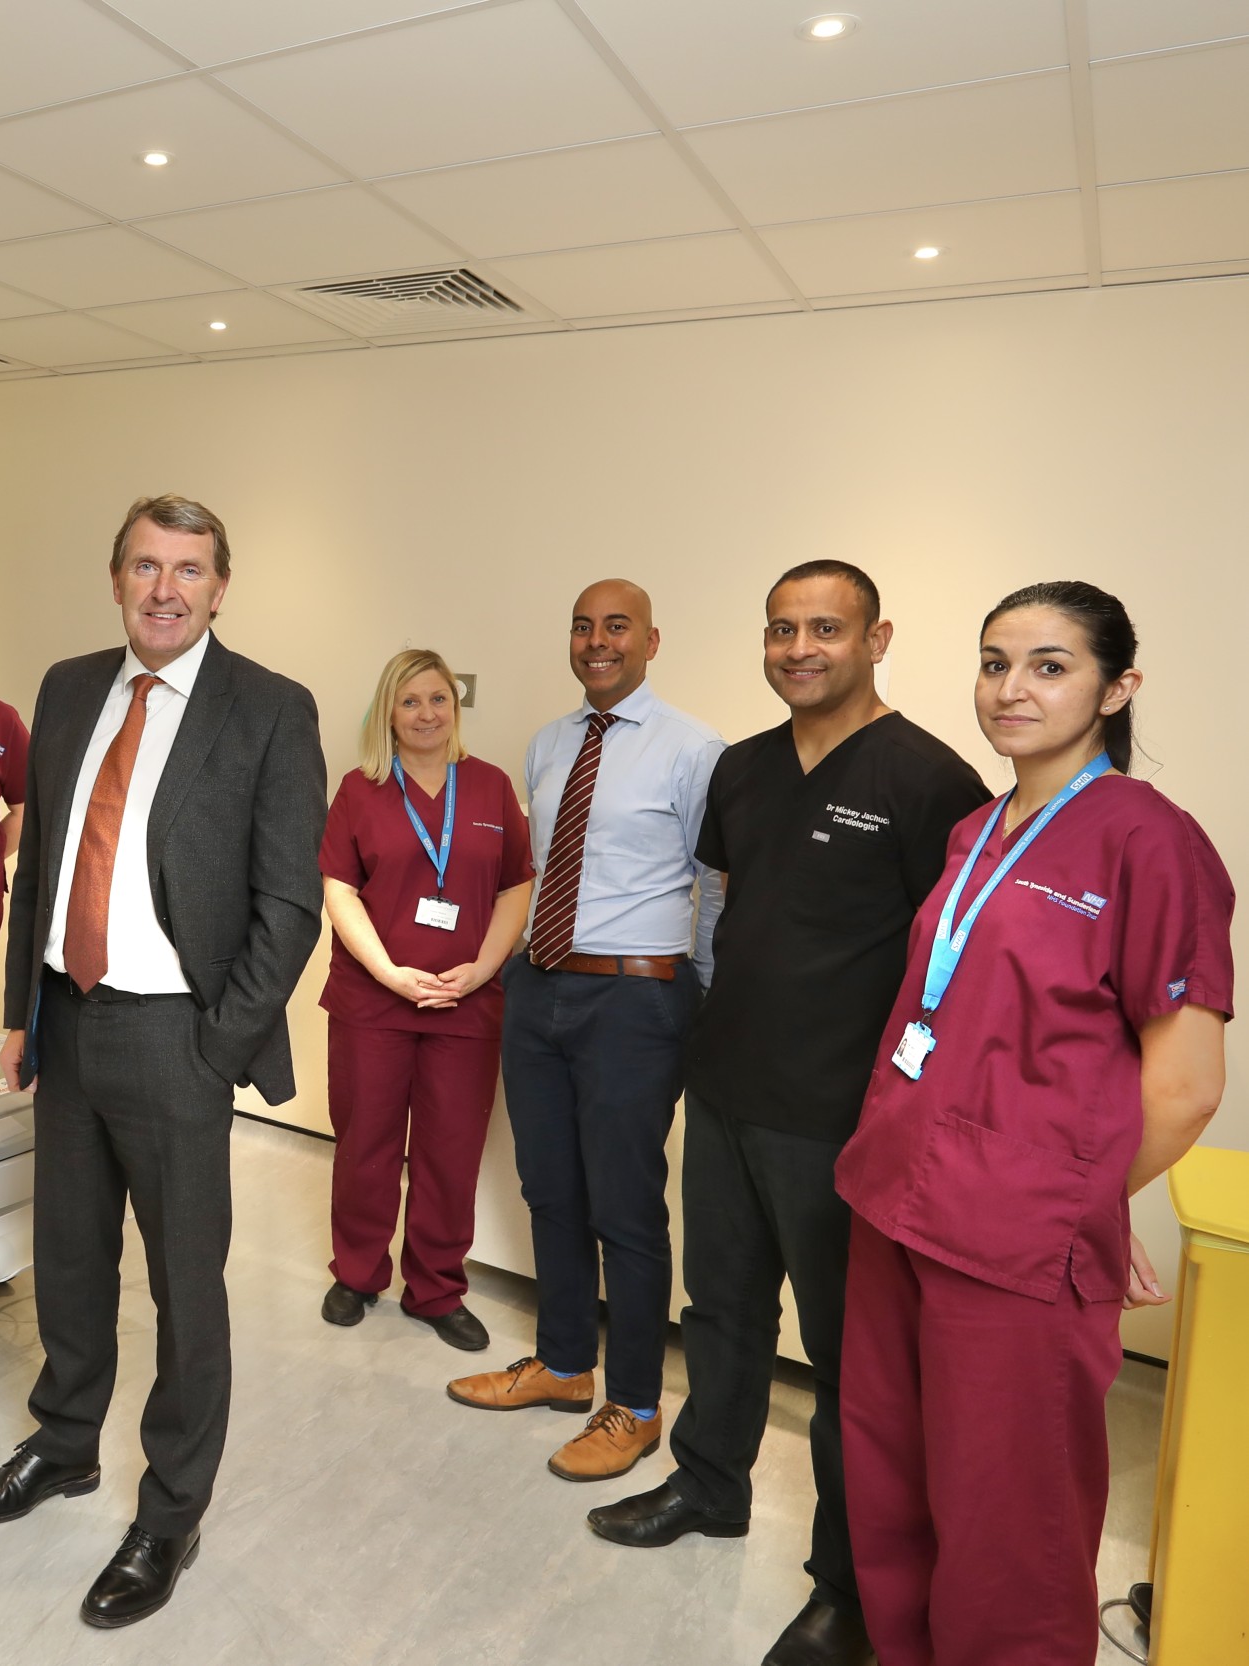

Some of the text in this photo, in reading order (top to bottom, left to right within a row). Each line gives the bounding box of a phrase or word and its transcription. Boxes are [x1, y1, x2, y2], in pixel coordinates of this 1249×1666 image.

[1070, 772, 1091, 791] NHS
[826, 804, 835, 812] Dr
[835, 805, 861, 819] Mickey
[1048, 796, 1065, 812] South
[833, 814, 880, 832] Cardiologist
[1053, 891, 1067, 900] and
[1067, 897, 1100, 915] Sunderland
[1083, 893, 1105, 907] NHS
[951, 930, 965, 951] NHS
